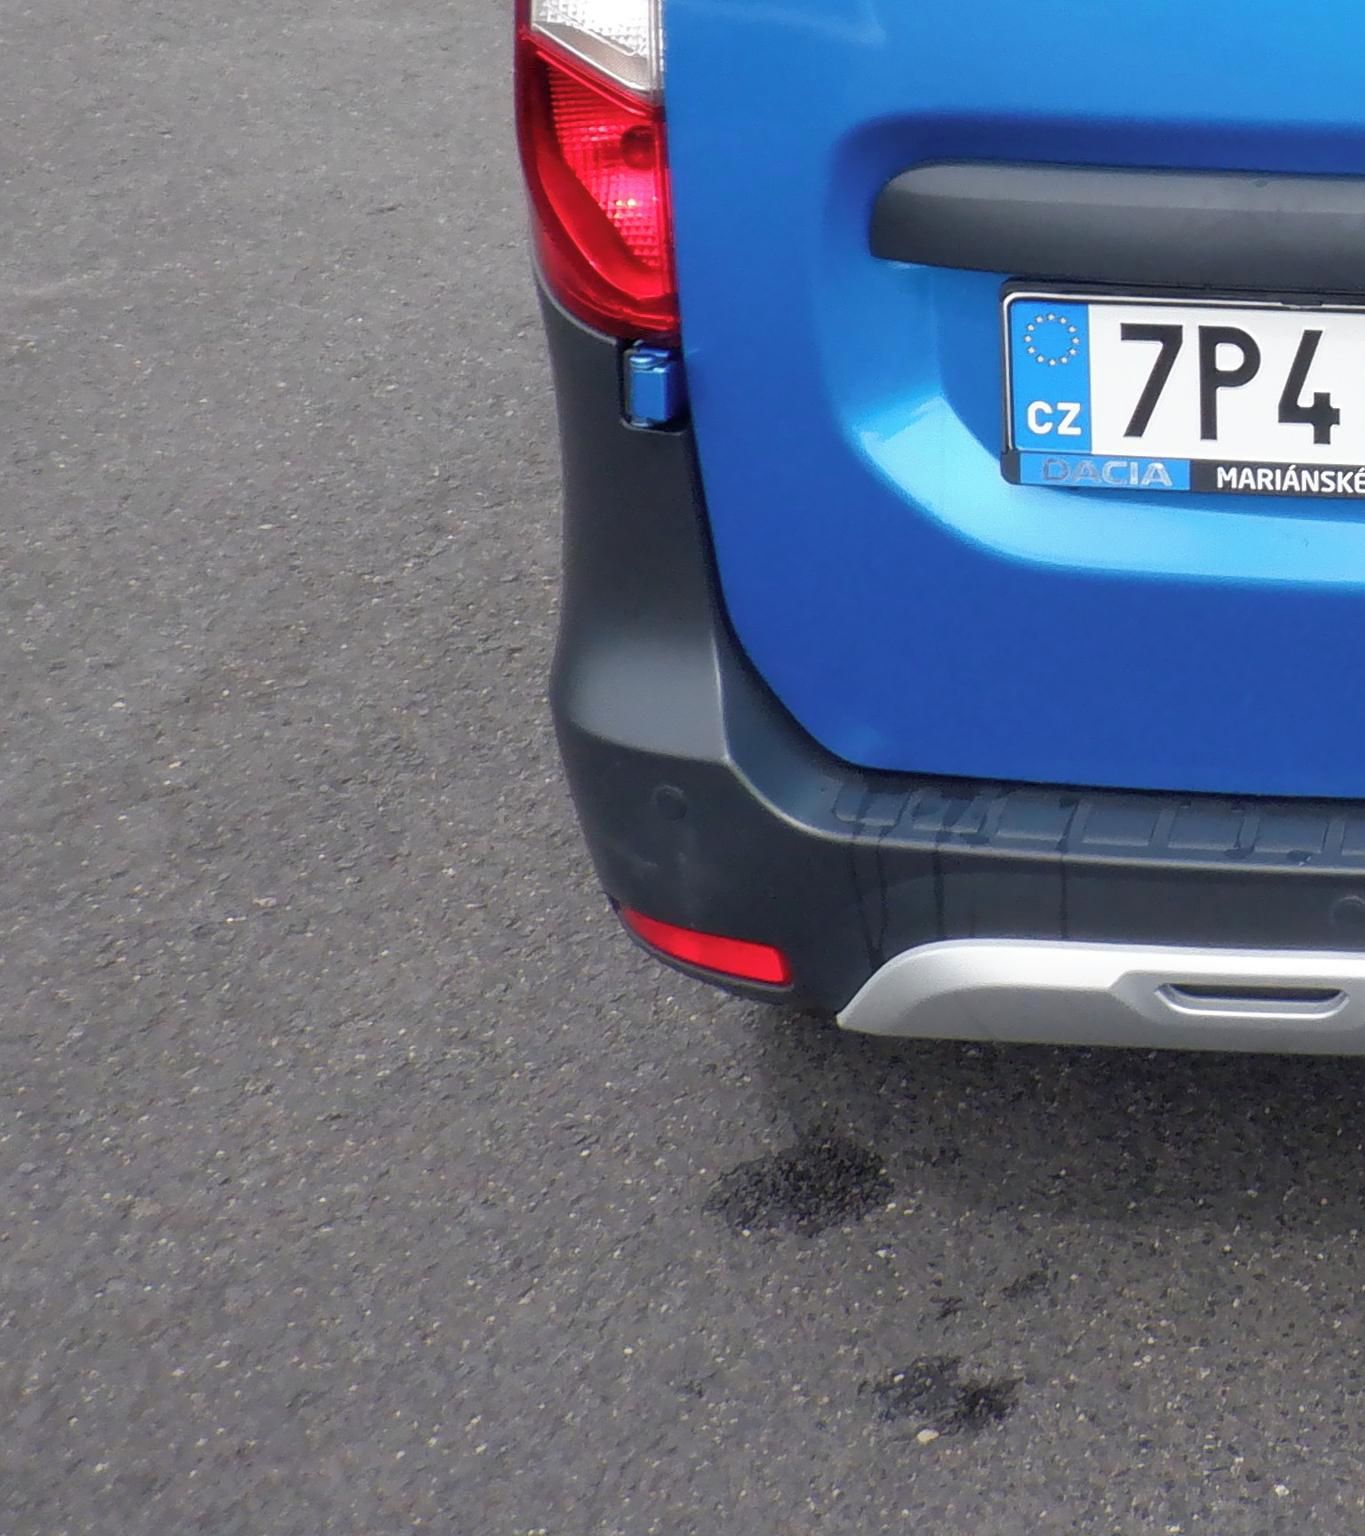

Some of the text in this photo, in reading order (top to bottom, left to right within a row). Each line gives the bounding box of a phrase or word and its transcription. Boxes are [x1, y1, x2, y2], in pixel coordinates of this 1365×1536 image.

[1120, 322, 1341, 446] 7P4
[1026, 400, 1082, 436] CZ
[1042, 458, 1173, 487] DACIA
